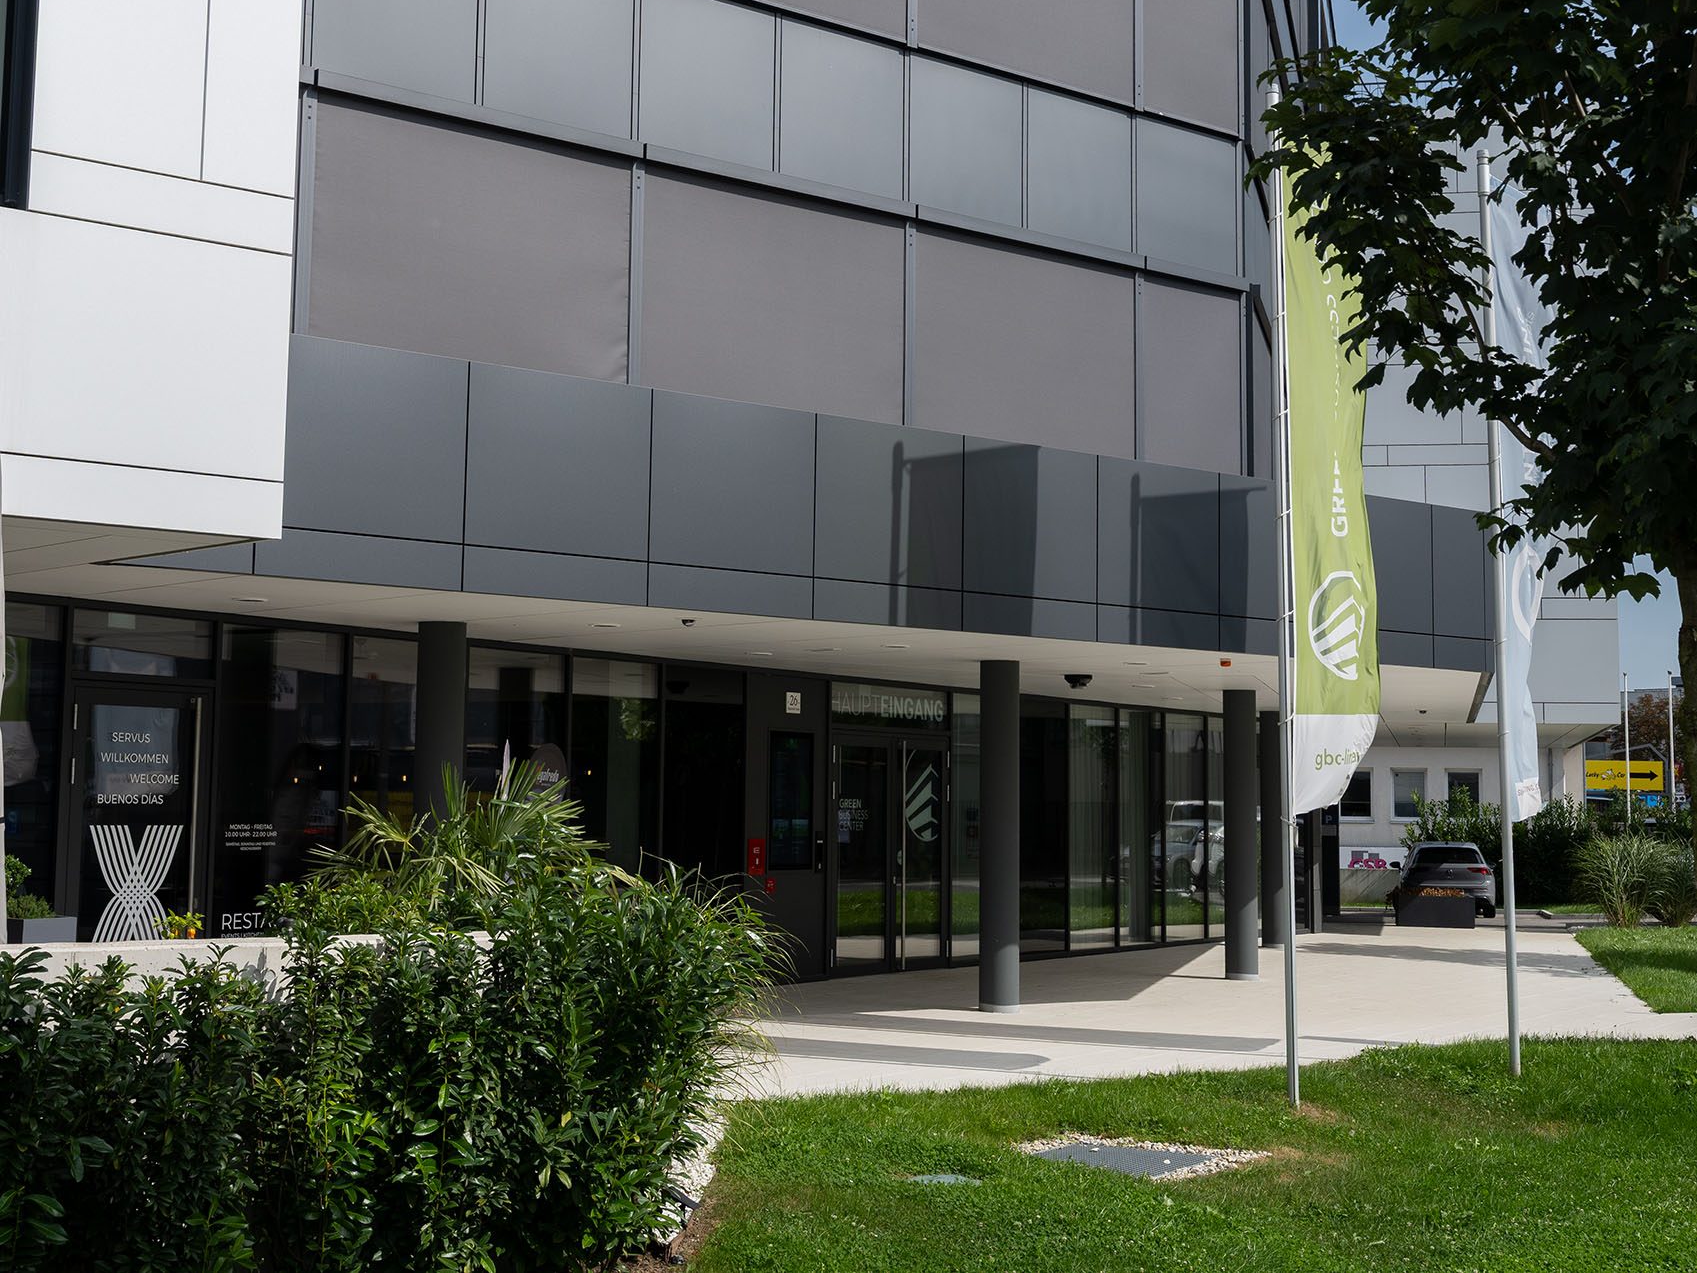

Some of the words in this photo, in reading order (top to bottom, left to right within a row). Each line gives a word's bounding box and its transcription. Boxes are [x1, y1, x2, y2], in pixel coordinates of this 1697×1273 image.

[832, 691, 944, 721] HAUPTEINGANG
[112, 732, 151, 743] SERVUS
[101, 752, 169, 764] WILLKOMMEN
[130, 774, 180, 785] WELCOME
[97, 793, 139, 804] BUENOS
[141, 792, 164, 805] DÍAS
[839, 798, 862, 808] GREEN
[839, 809, 869, 821] BUSINESS
[839, 821, 864, 831] CENTER
